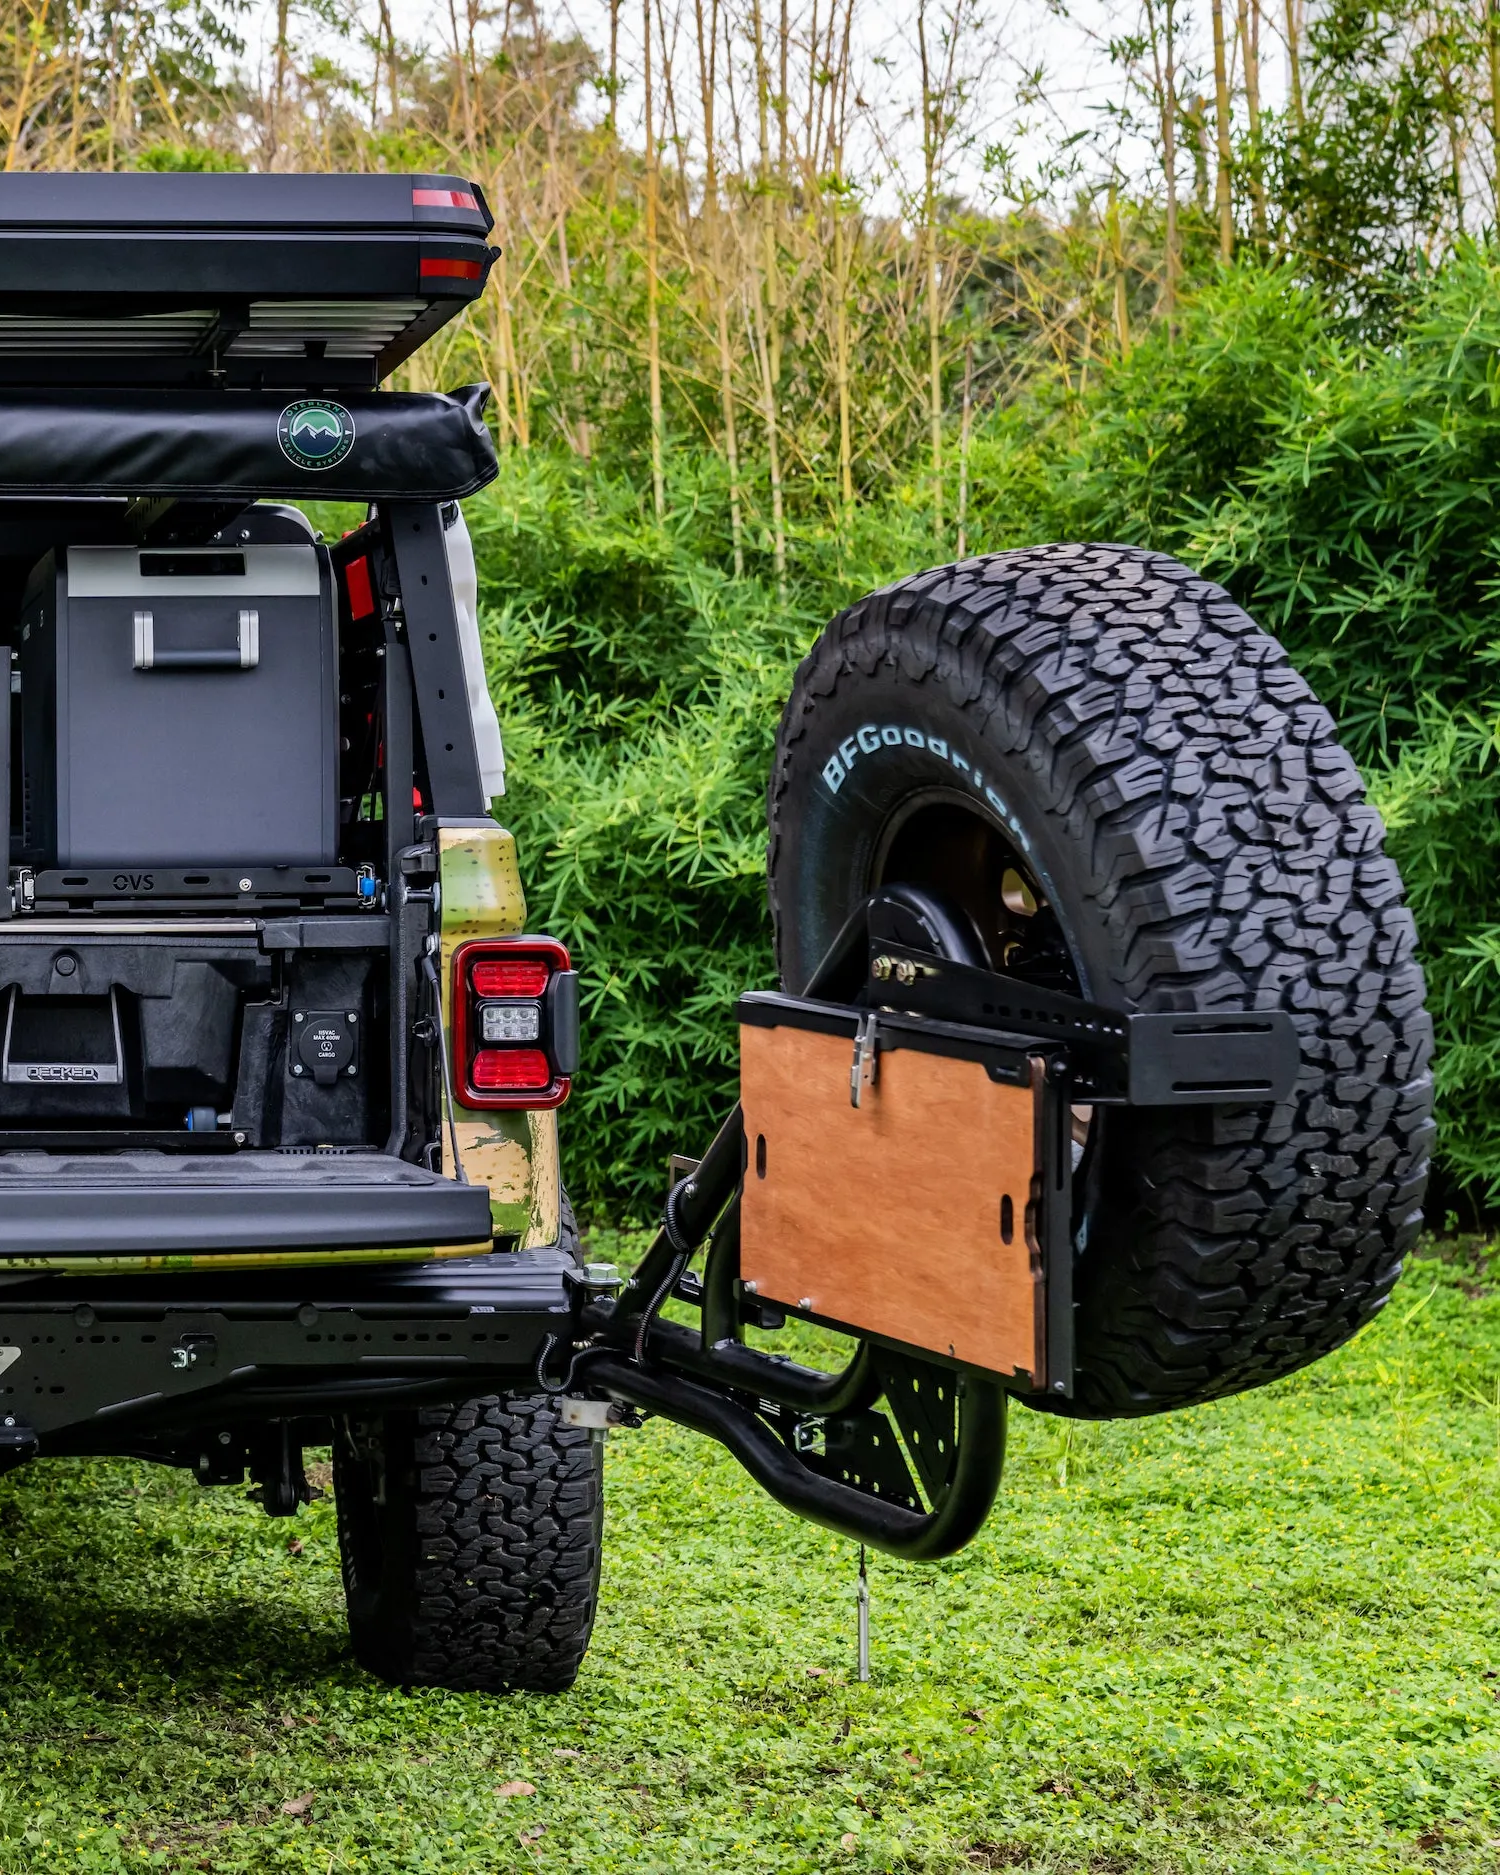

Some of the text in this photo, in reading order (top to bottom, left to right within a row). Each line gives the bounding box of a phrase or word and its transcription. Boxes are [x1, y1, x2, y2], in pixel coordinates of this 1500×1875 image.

[285, 401, 346, 419] OVERLAND
[283, 437, 350, 467] VEHICLE SYSTEMS
[821, 725, 1030, 852] BFGoodrich
[112, 874, 154, 891] OVS
[27, 1066, 99, 1081] DECKED
